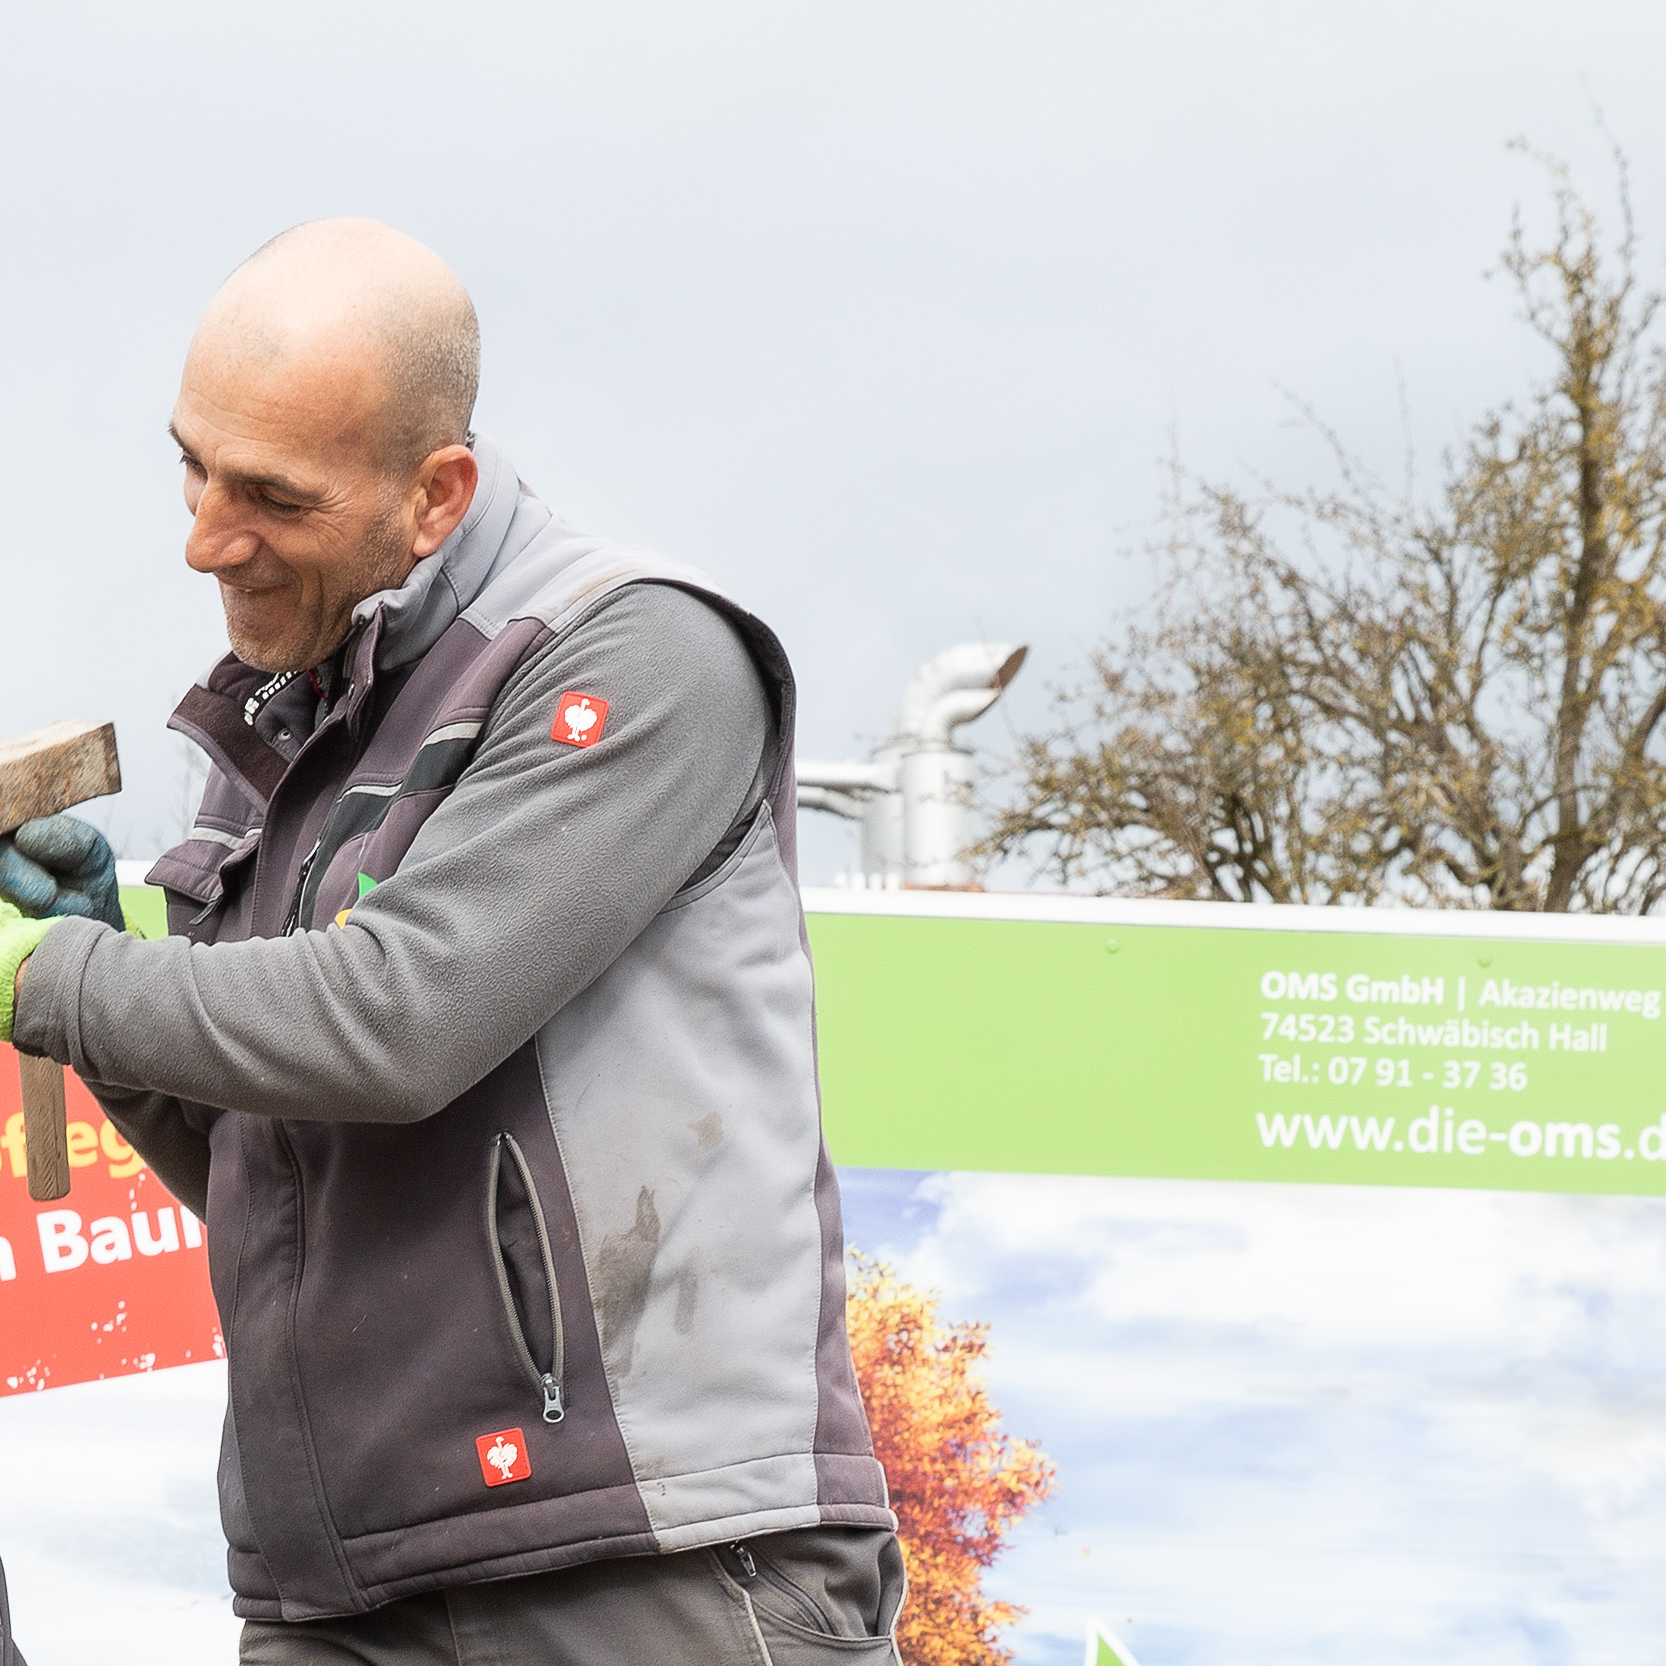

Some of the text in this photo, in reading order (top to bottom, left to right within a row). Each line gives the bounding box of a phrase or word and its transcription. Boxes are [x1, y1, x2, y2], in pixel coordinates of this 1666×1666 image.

[1260, 971, 1338, 1003] OMS
[1345, 973, 1445, 1006] GmbH
[1477, 977, 1662, 1021] Akazienweg
[1260, 1011, 1608, 1053] 74523 Schwäbisch Hall
[1258, 1053, 1321, 1084] Tel.:
[1328, 1055, 1367, 1086] 07
[1374, 1056, 1414, 1088] 91
[1442, 1059, 1482, 1090] 37
[1488, 1060, 1529, 1092] 36
